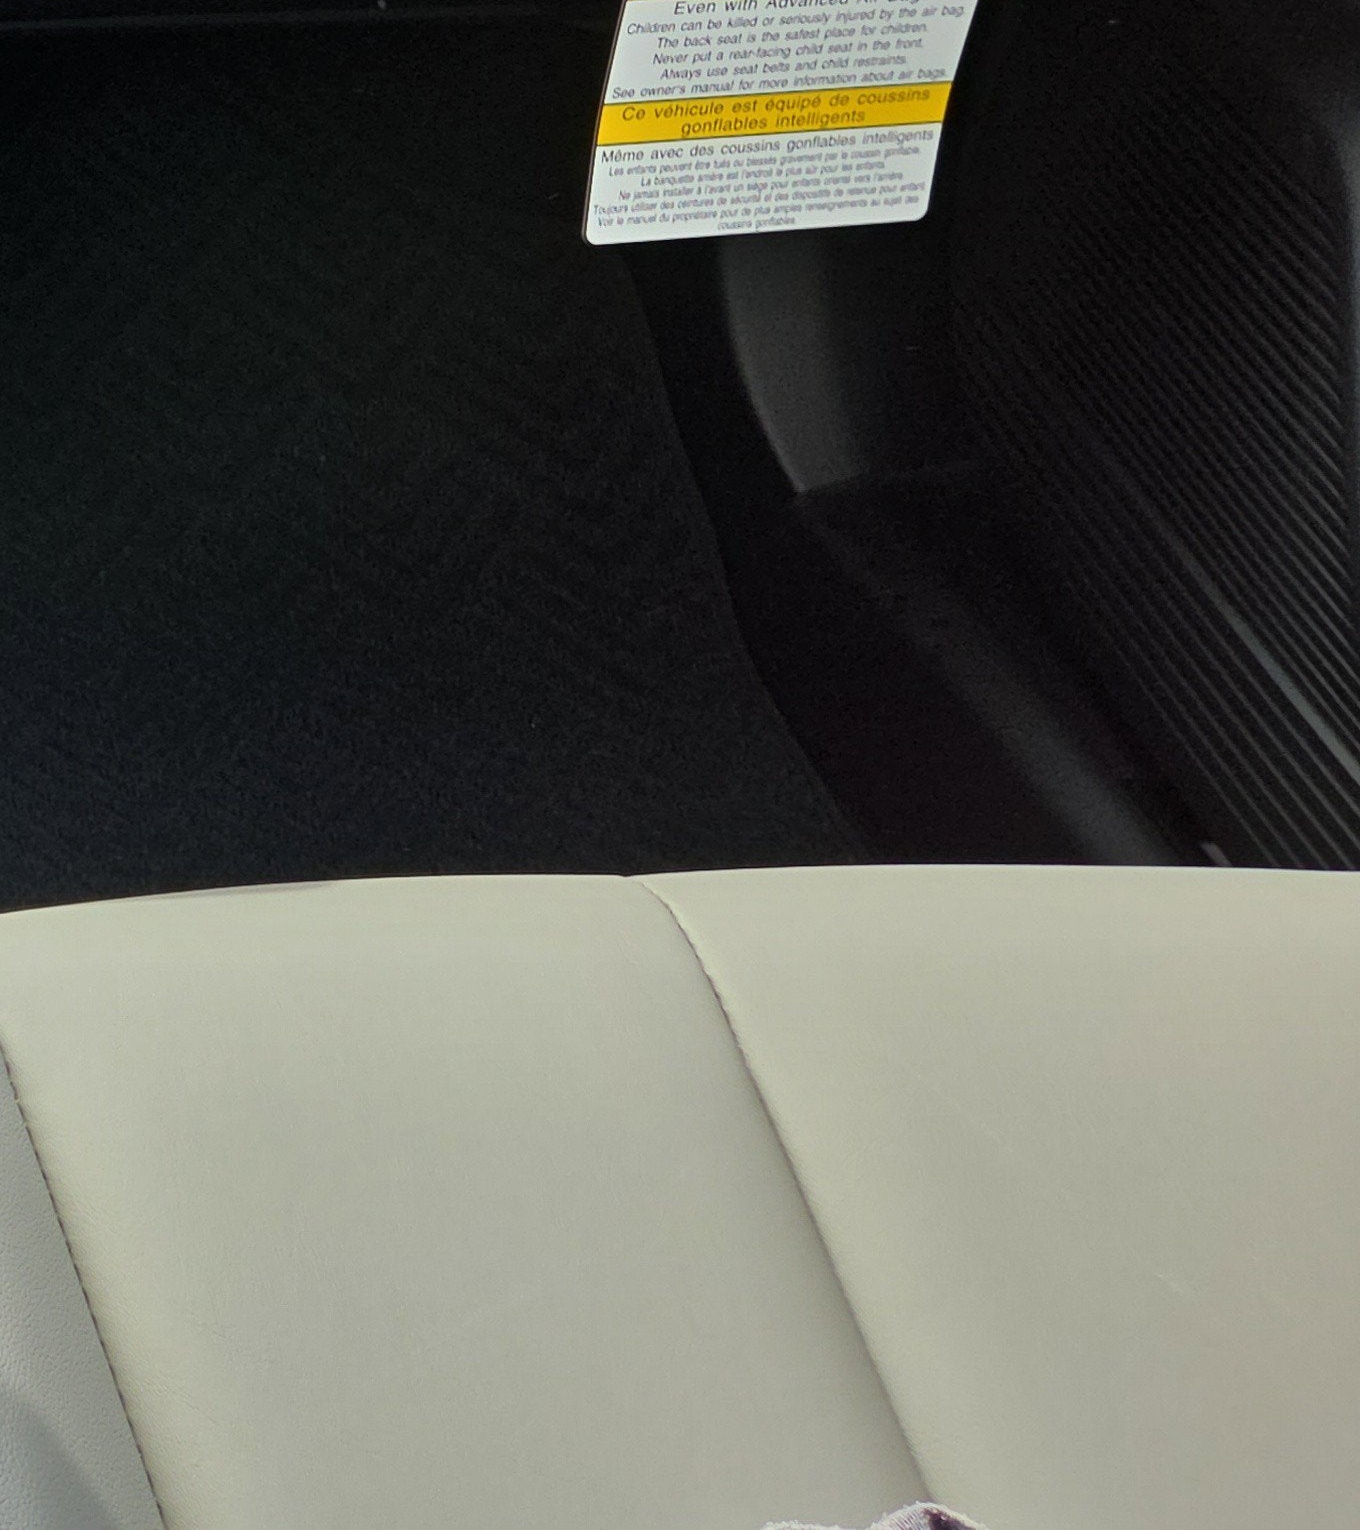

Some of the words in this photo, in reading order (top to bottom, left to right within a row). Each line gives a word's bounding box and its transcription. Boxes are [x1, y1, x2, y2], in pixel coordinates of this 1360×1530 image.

[628, 22, 675, 35] Children
[680, 23, 702, 31] can
[707, 20, 722, 29] be
[727, 17, 757, 27] killed
[762, 16, 775, 26] or
[780, 15, 830, 25] seriously
[836, 9, 875, 21] injured
[879, 10, 894, 21] by
[899, 6, 917, 17] the
[921, 6, 937, 16] air
[674, 1, 716, 15] Even
[725, 0, 757, 11] with
[658, 37, 678, 48] The
[684, 35, 711, 46] back
[717, 34, 742, 45] seat
[747, 32, 756, 42] is
[762, 31, 779, 42] the
[785, 28, 820, 39] safest
[824, 27, 856, 39] place
[861, 25, 876, 36] for
[653, 53, 688, 65] Never
[692, 51, 711, 64] put
[716, 51, 724, 60] a
[796, 43, 823, 55] child
[827, 41, 852, 53] seat
[857, 40, 867, 51] in
[873, 39, 890, 51] the
[660, 68, 701, 80] Always
[707, 67, 728, 76] use
[733, 64, 758, 75] seat
[795, 59, 817, 71] and
[822, 58, 849, 69] child
[613, 87, 635, 99] See
[691, 80, 734, 94] manual
[738, 77, 753, 90] for
[758, 78, 788, 88] more
[793, 72, 857, 86] information
[861, 70, 894, 82] about
[622, 107, 646, 121] Ce
[654, 102, 723, 119] véhicule
[732, 100, 757, 113] est
[765, 94, 821, 112] équipé
[829, 93, 849, 107] de
[857, 89, 930, 105] coussins
[681, 118, 767, 137] gonflables
[775, 110, 866, 128] intelligents
[602, 149, 644, 163] Même
[651, 147, 683, 159] avec
[690, 145, 714, 157] des
[721, 139, 780, 150] coussins
[787, 134, 856, 153] gonflables
[862, 129, 934, 145] intelligents
